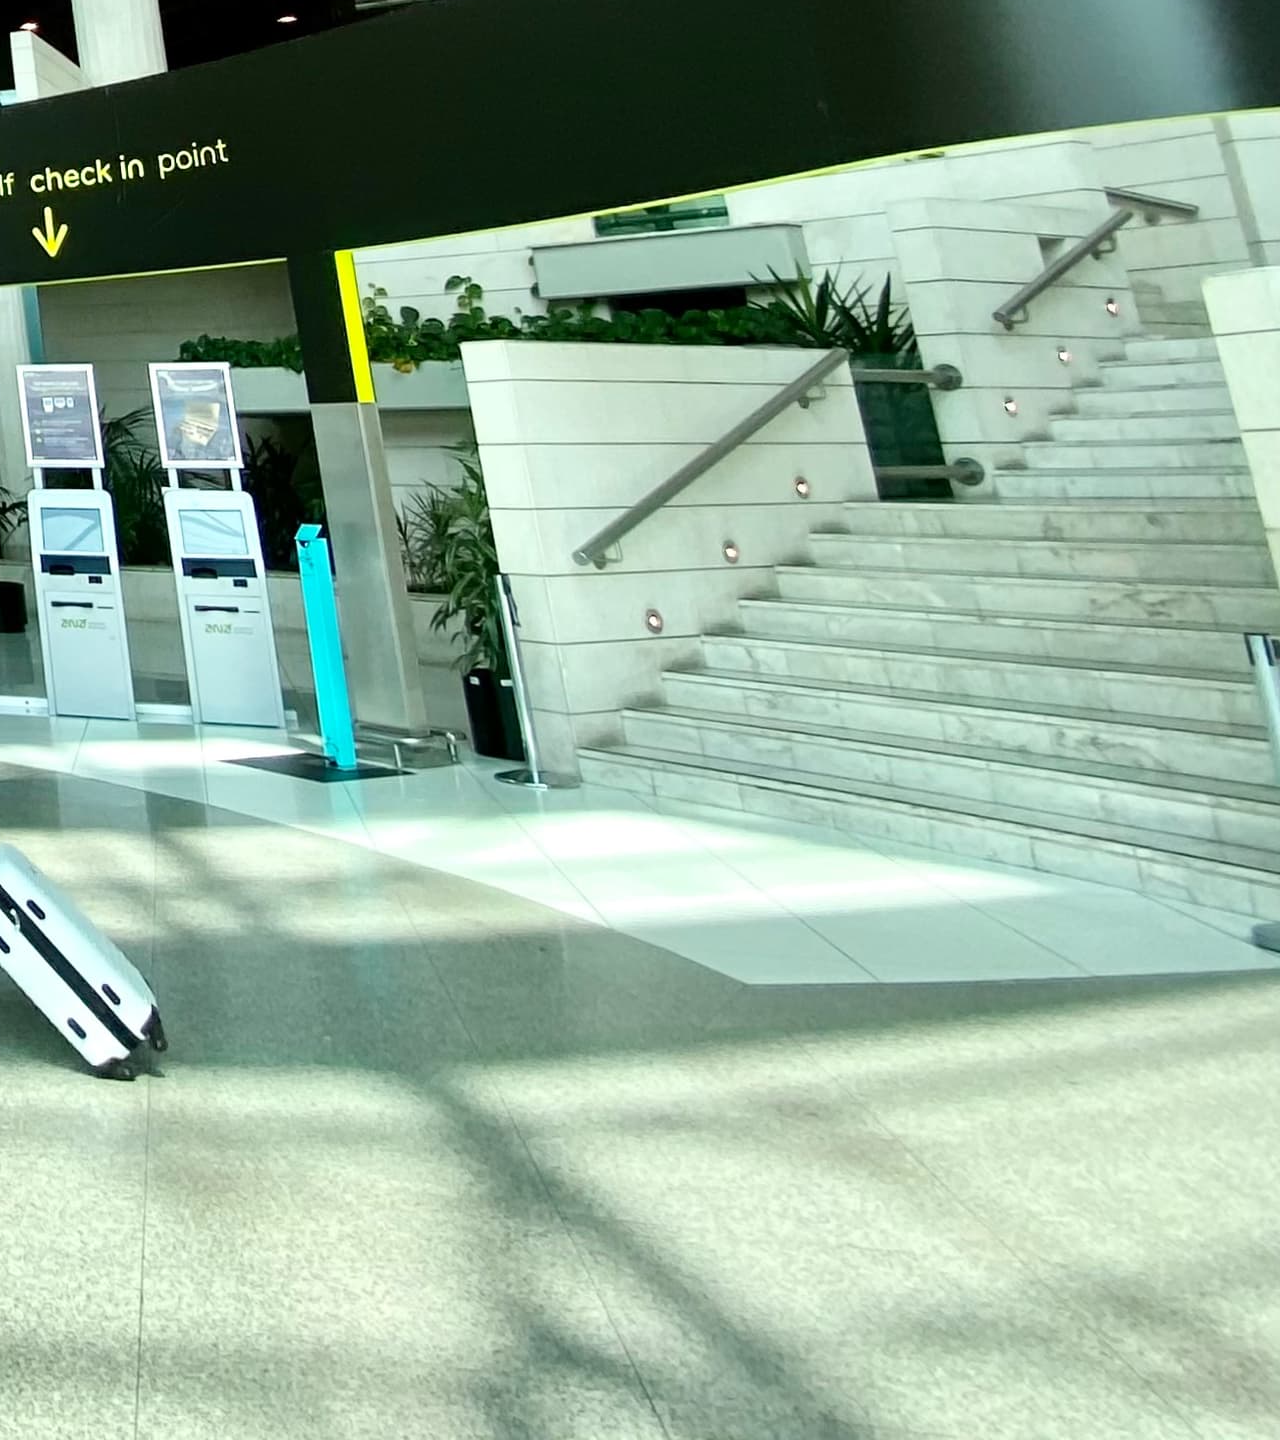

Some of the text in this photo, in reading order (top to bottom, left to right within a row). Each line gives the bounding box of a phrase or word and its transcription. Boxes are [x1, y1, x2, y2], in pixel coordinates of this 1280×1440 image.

[30, 159, 112, 193] check
[119, 155, 144, 180] in
[158, 139, 229, 180] point
